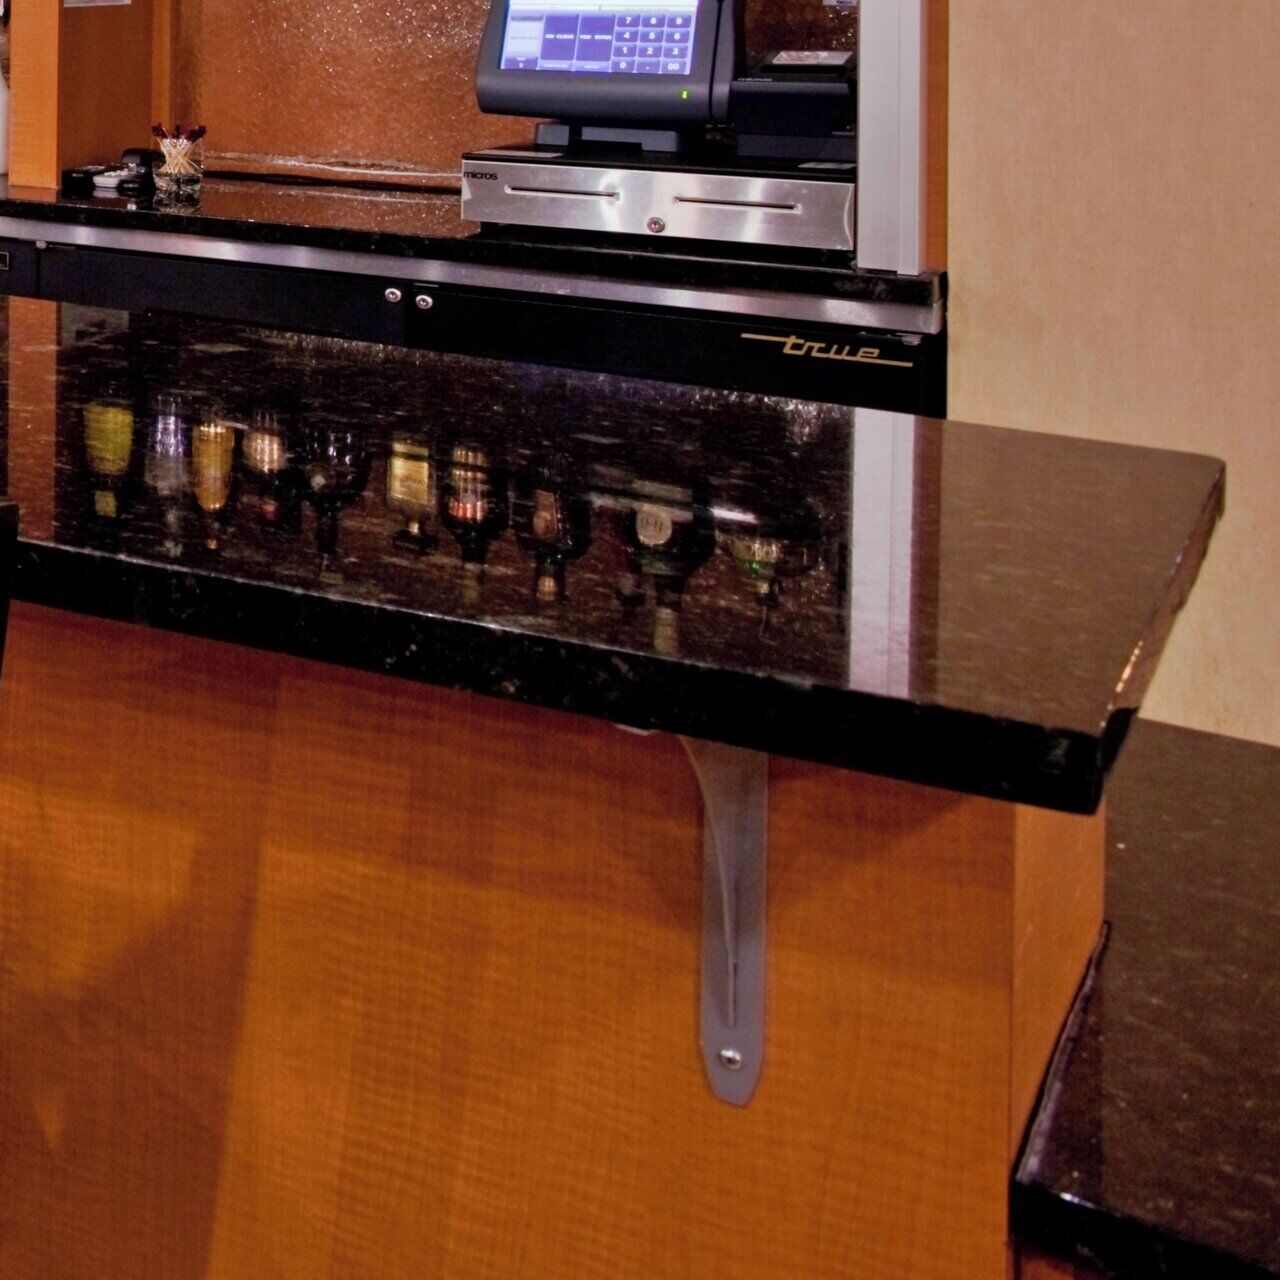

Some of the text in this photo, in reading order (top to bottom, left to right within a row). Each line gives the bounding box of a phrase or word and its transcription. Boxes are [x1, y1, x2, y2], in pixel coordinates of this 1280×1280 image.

[625, 17, 683, 25] 7 8 9
[623, 32, 681, 40] 4 5 6
[646, 47, 654, 55] 2
[672, 47, 679, 55] 3
[620, 61, 627, 69] 0
[668, 62, 680, 70] 00
[463, 170, 499, 180] micros
